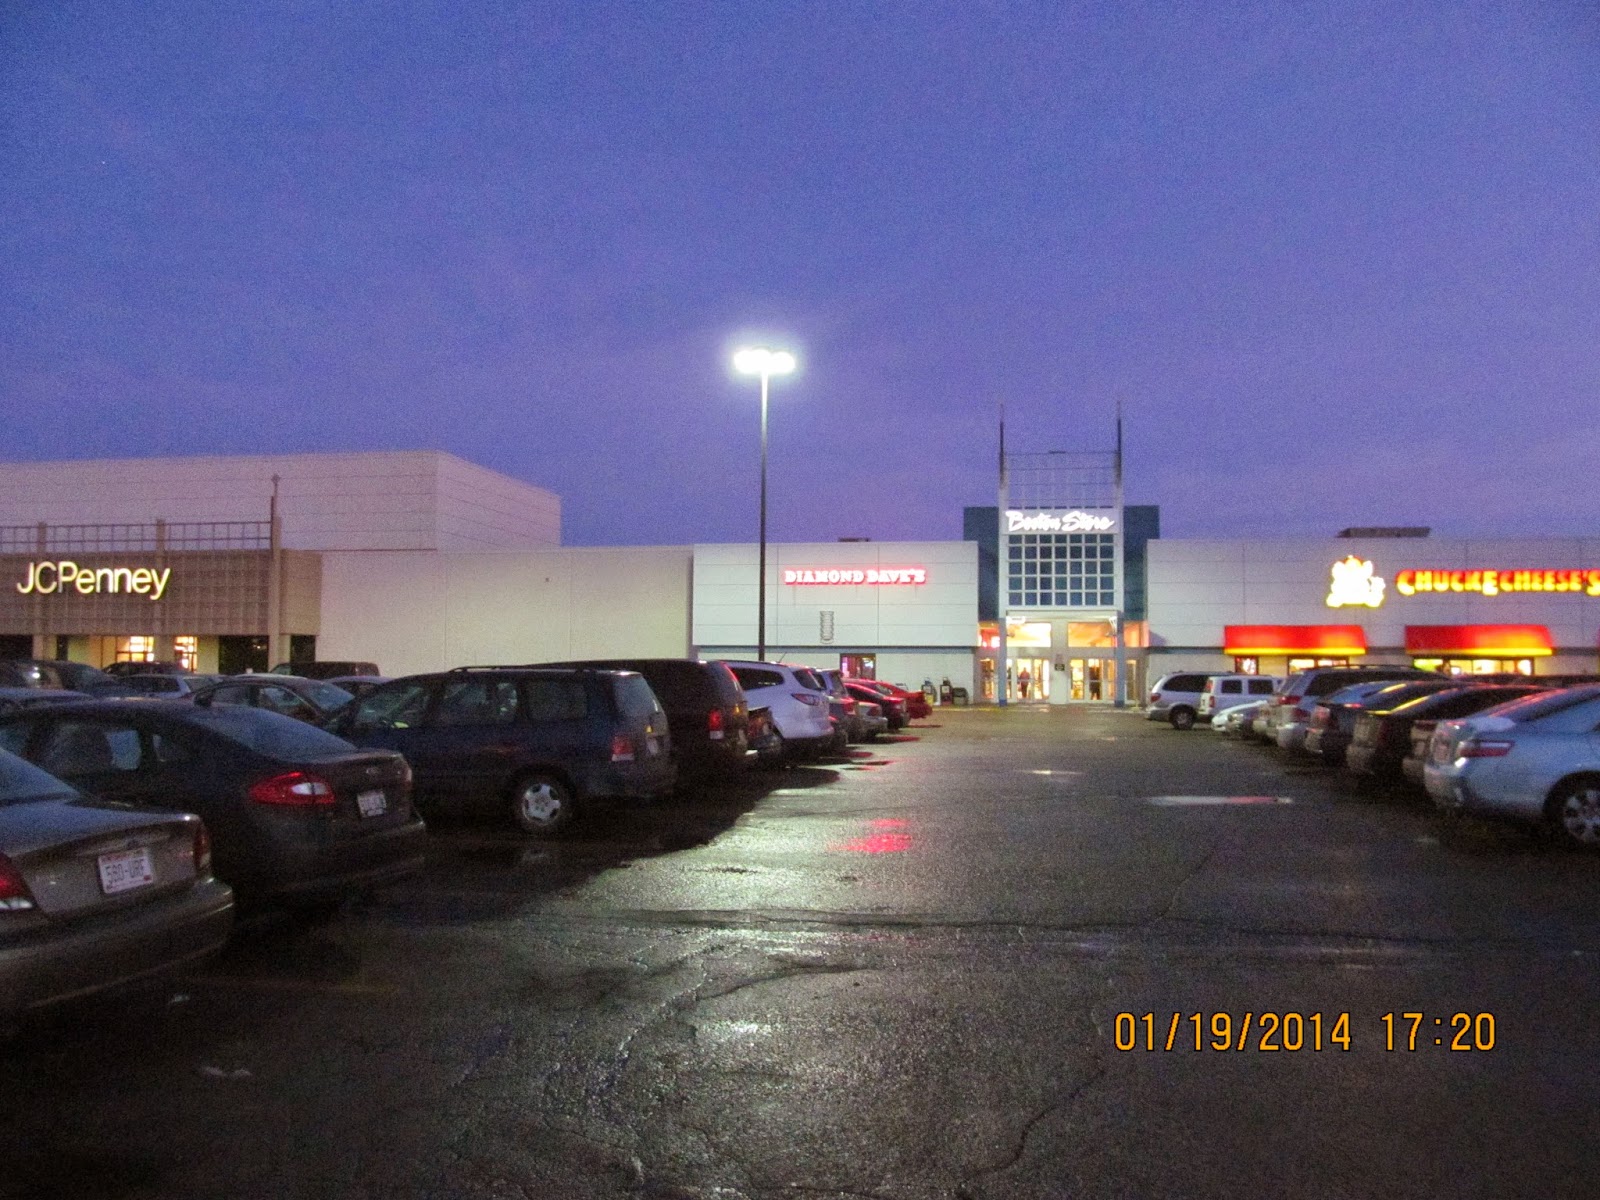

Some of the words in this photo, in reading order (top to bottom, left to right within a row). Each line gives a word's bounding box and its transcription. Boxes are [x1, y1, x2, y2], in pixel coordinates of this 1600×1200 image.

[1005, 511, 1060, 532] Boston
[1061, 510, 1115, 532] Store
[16, 561, 171, 600] JCPenney
[784, 570, 865, 584] DIAMOND
[867, 568, 927, 584] DAVE'S
[1397, 569, 1482, 595] CHUCK
